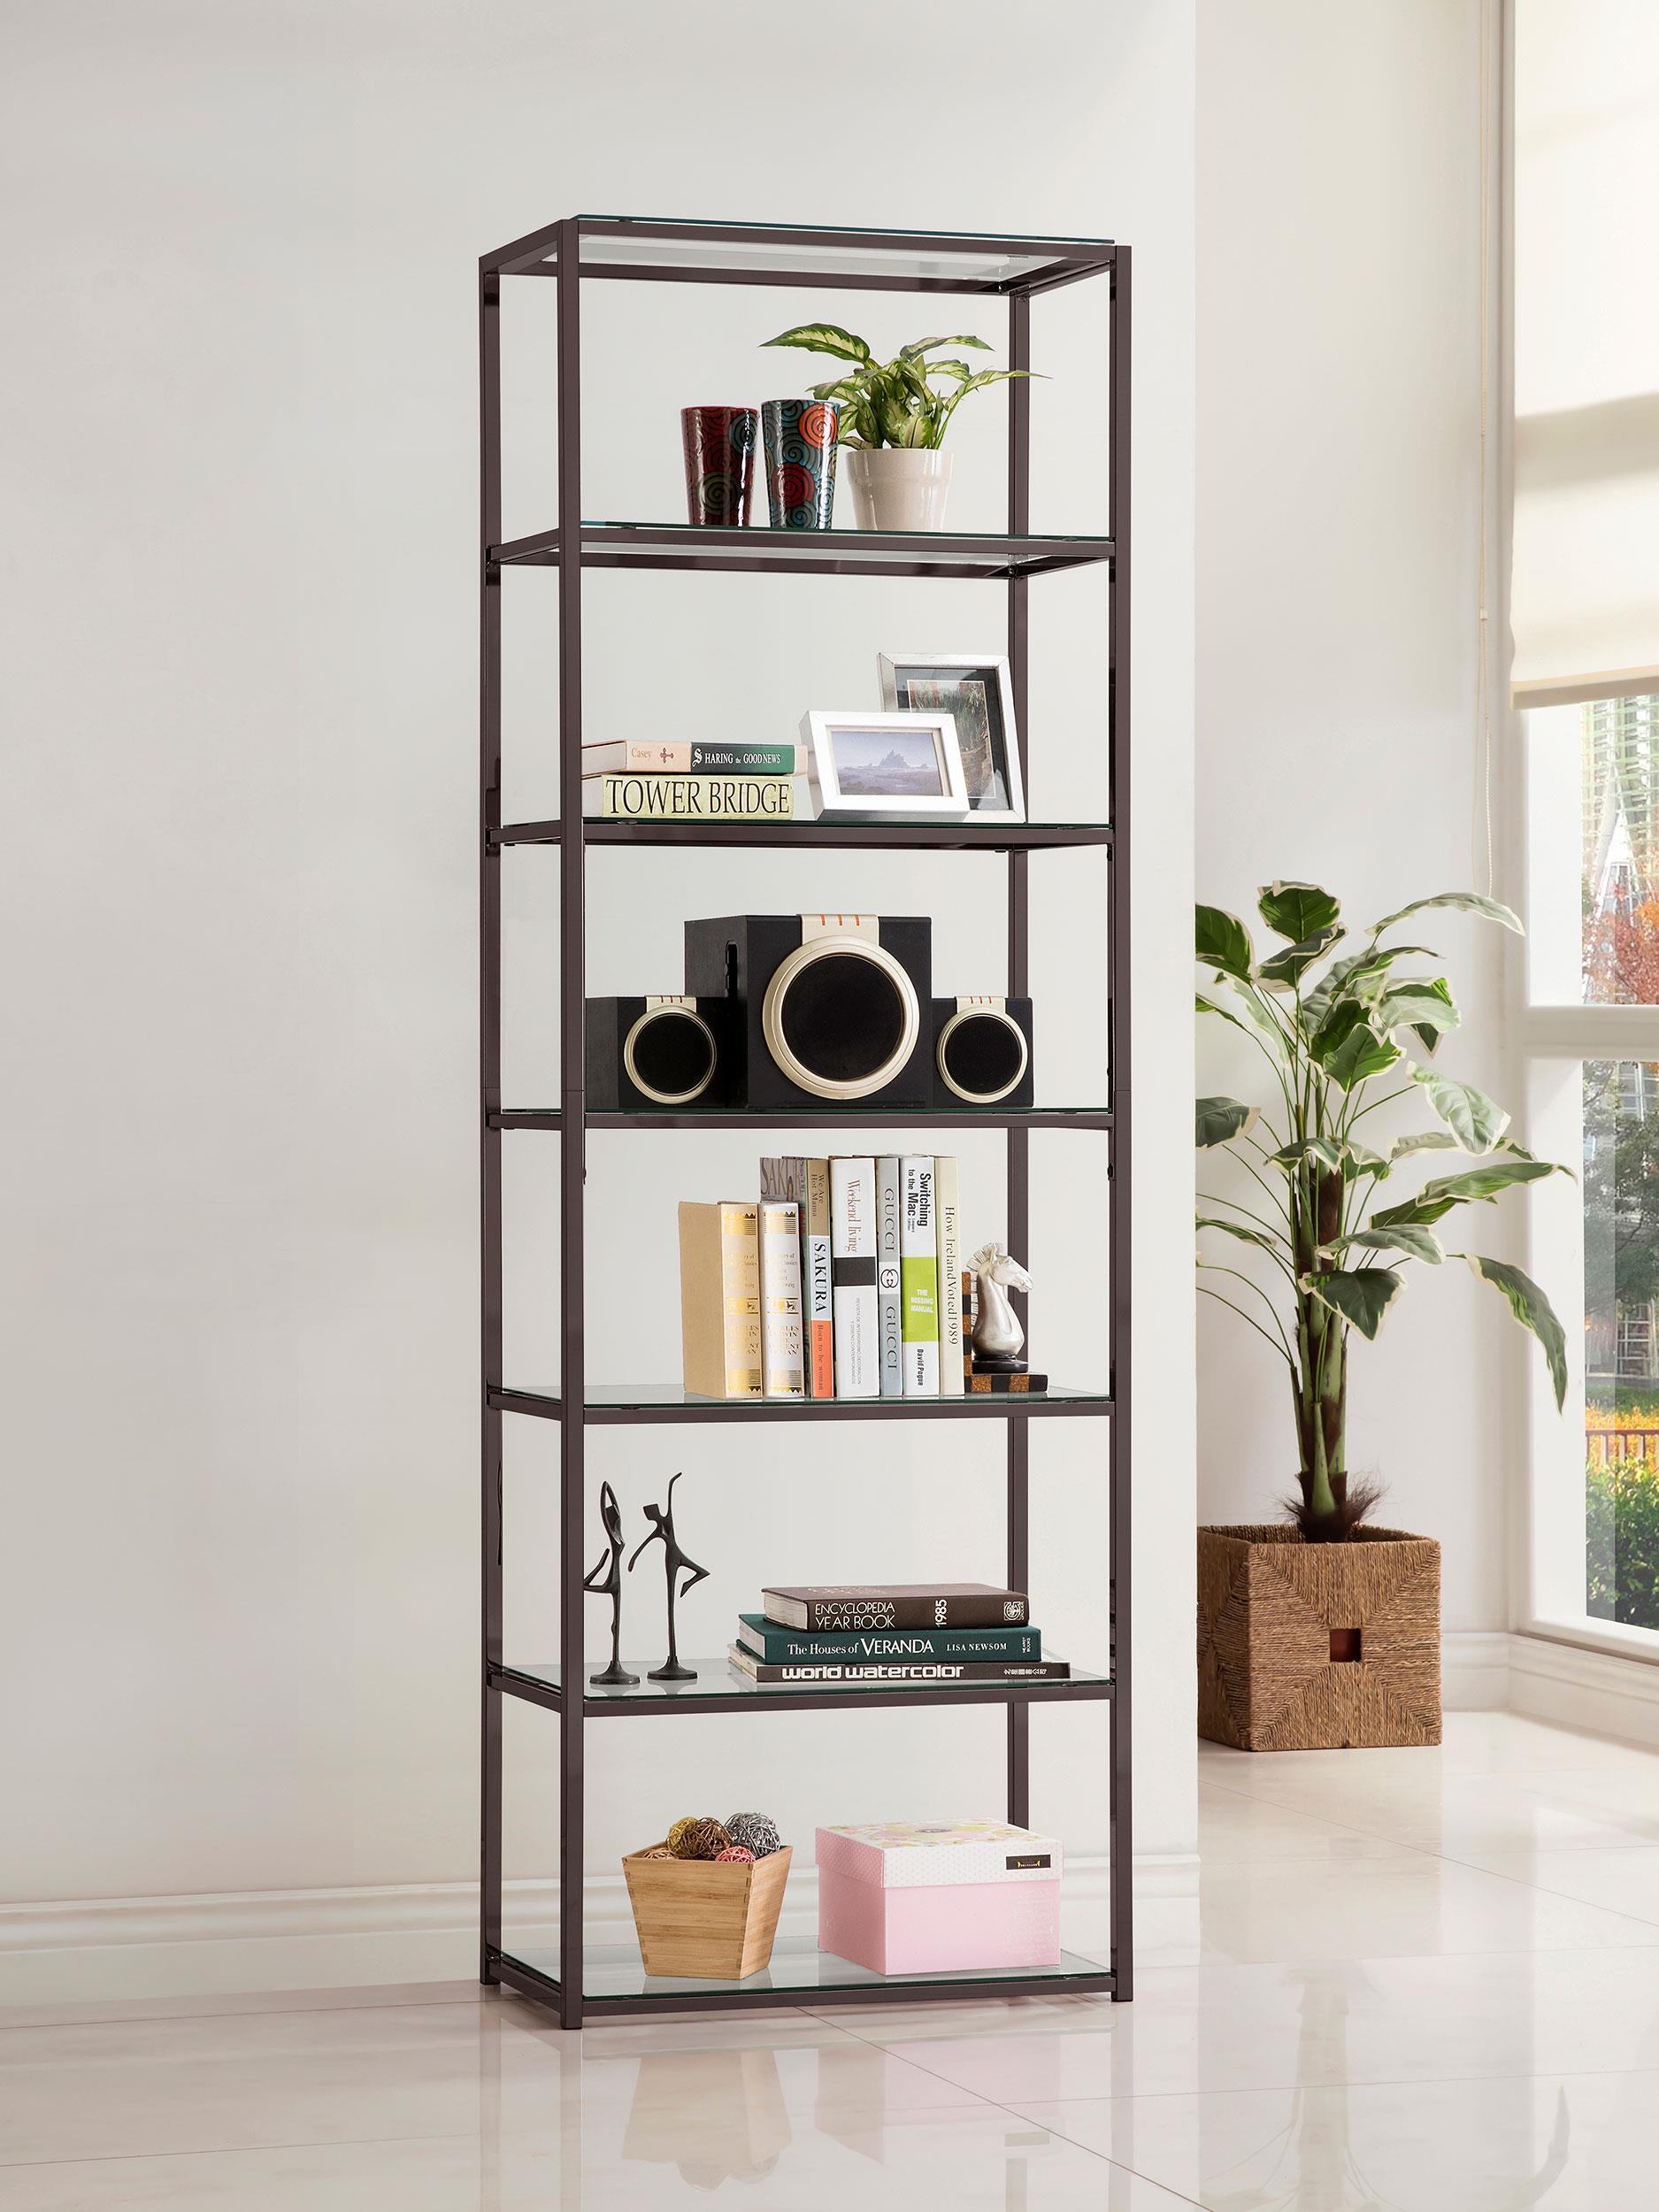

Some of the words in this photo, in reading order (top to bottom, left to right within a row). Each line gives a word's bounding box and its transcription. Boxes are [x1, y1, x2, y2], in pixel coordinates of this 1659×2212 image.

[631, 747, 652, 758] Casey
[743, 753, 763, 764] GOOD
[764, 753, 781, 764] NEWS
[606, 779, 703, 814] TOWER
[709, 781, 790, 814] BRIDGE
[818, 1174, 825, 1187] We
[847, 1179, 861, 1222] Weekend
[907, 1192, 919, 1217] Mac
[917, 1172, 932, 1227] Switching
[885, 1187, 895, 1251] GUCCI
[945, 1206, 955, 1233] How
[844, 1226, 861, 1253] living
[946, 1239, 956, 1280] Ireland
[814, 1242, 827, 1313] SAKURA
[818, 1343, 824, 1353] to
[886, 1305, 897, 1370] GUCCI
[818, 1354, 824, 1364] be
[815, 1601, 895, 1615] ENCYCLOPEDIA
[934, 1599, 948, 1628] 1985
[815, 1617, 850, 1630] YEAR
[854, 1615, 895, 1629] BOOK
[787, 1643, 808, 1655] The
[810, 1643, 846, 1655] Houses
[848, 1642, 859, 1654] of
[860, 1637, 935, 1657] VERANDA
[946, 1643, 966, 1652] LISA
[968, 1642, 1008, 1651] NEWSOM
[781, 1665, 841, 1679] world
[845, 1664, 964, 1678] watercolor
